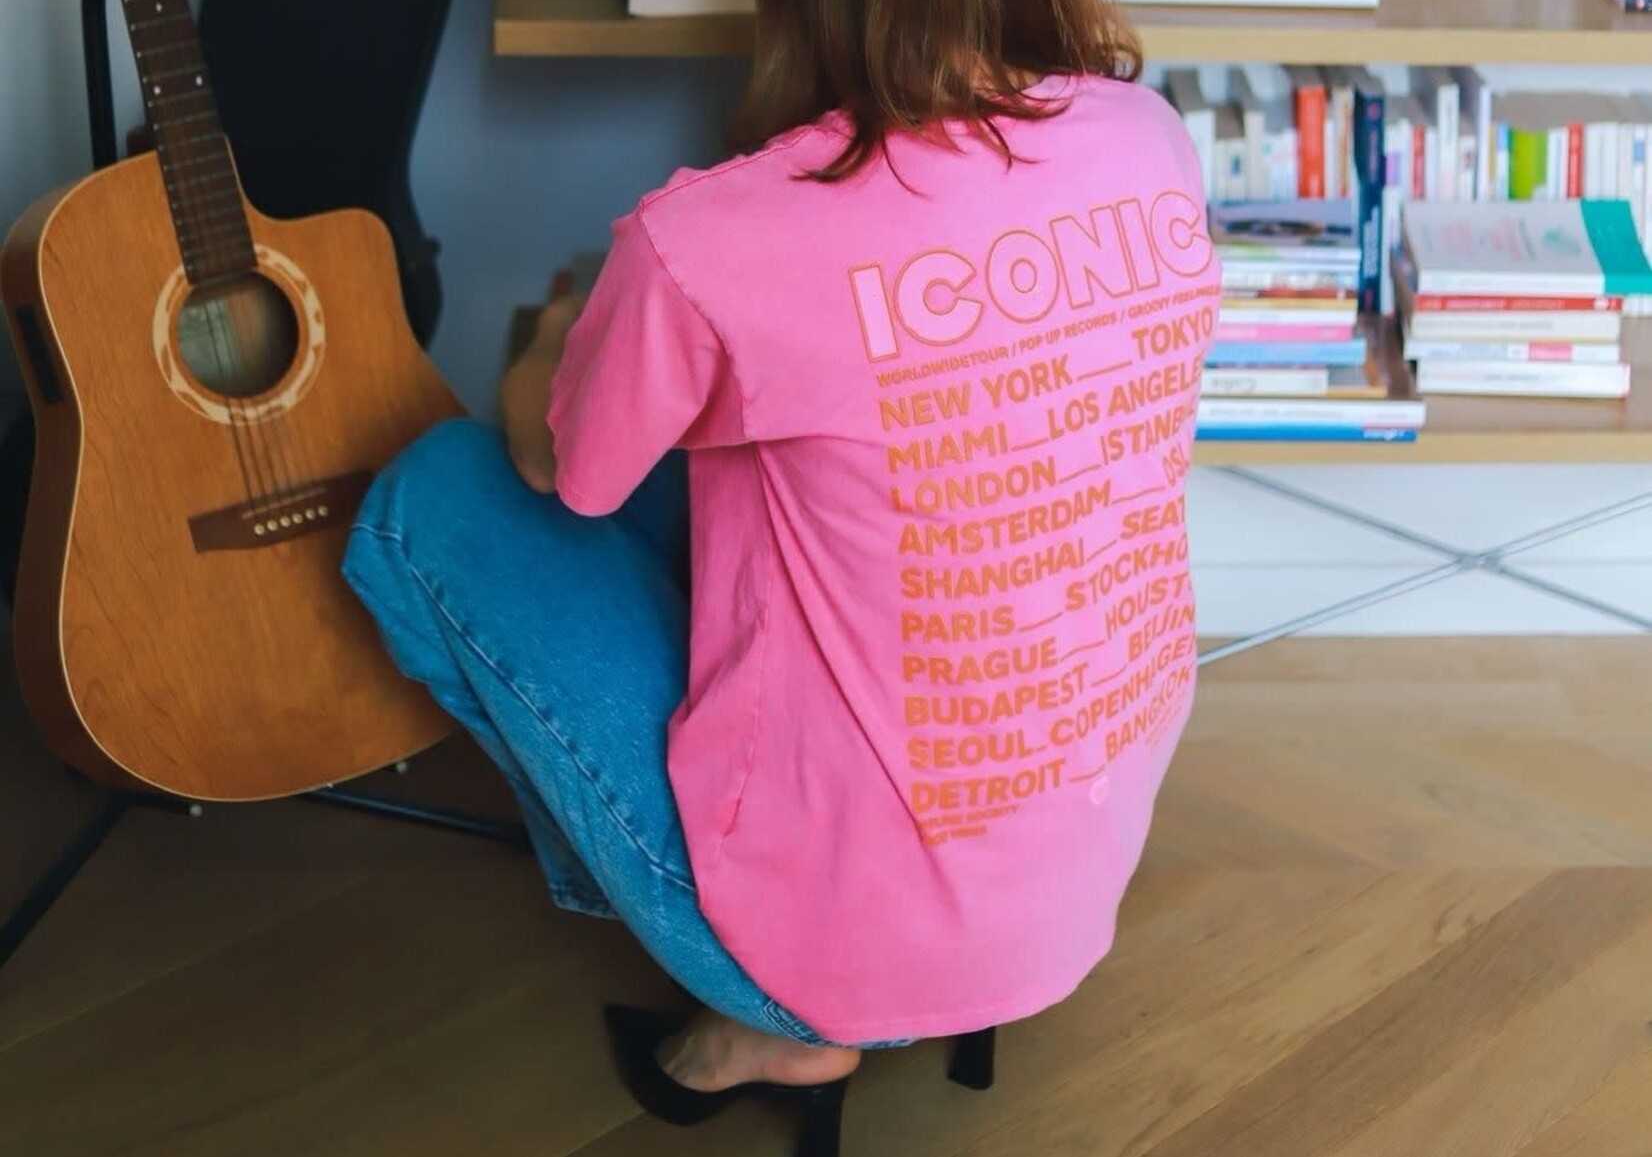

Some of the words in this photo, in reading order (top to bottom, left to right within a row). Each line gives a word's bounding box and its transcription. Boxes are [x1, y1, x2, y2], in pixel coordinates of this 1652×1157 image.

[848, 191, 1214, 363] ICONIC
[1018, 336, 1043, 354] POP
[1043, 330, 1061, 346] UP
[1062, 311, 1117, 340] RECORDS
[1127, 296, 1170, 319] GROOVY
[1130, 305, 1214, 361] TOKYO
[879, 381, 971, 432] NEW
[980, 354, 1074, 409] YORK
[886, 421, 1011, 475] MIAMI
[1046, 390, 1100, 441] LOS
[889, 455, 1058, 514] LONDON
[898, 477, 1111, 557] AMSTERDAM
[900, 536, 1085, 601] SHANGHAI
[901, 604, 1015, 644] PARIS
[902, 636, 1058, 685] PRAGUE
[904, 661, 1090, 727] BUDAPEST
[906, 728, 1034, 772] SEOUL
[910, 757, 1066, 814] DETROIT
[1105, 664, 1190, 764] BANGKOK
